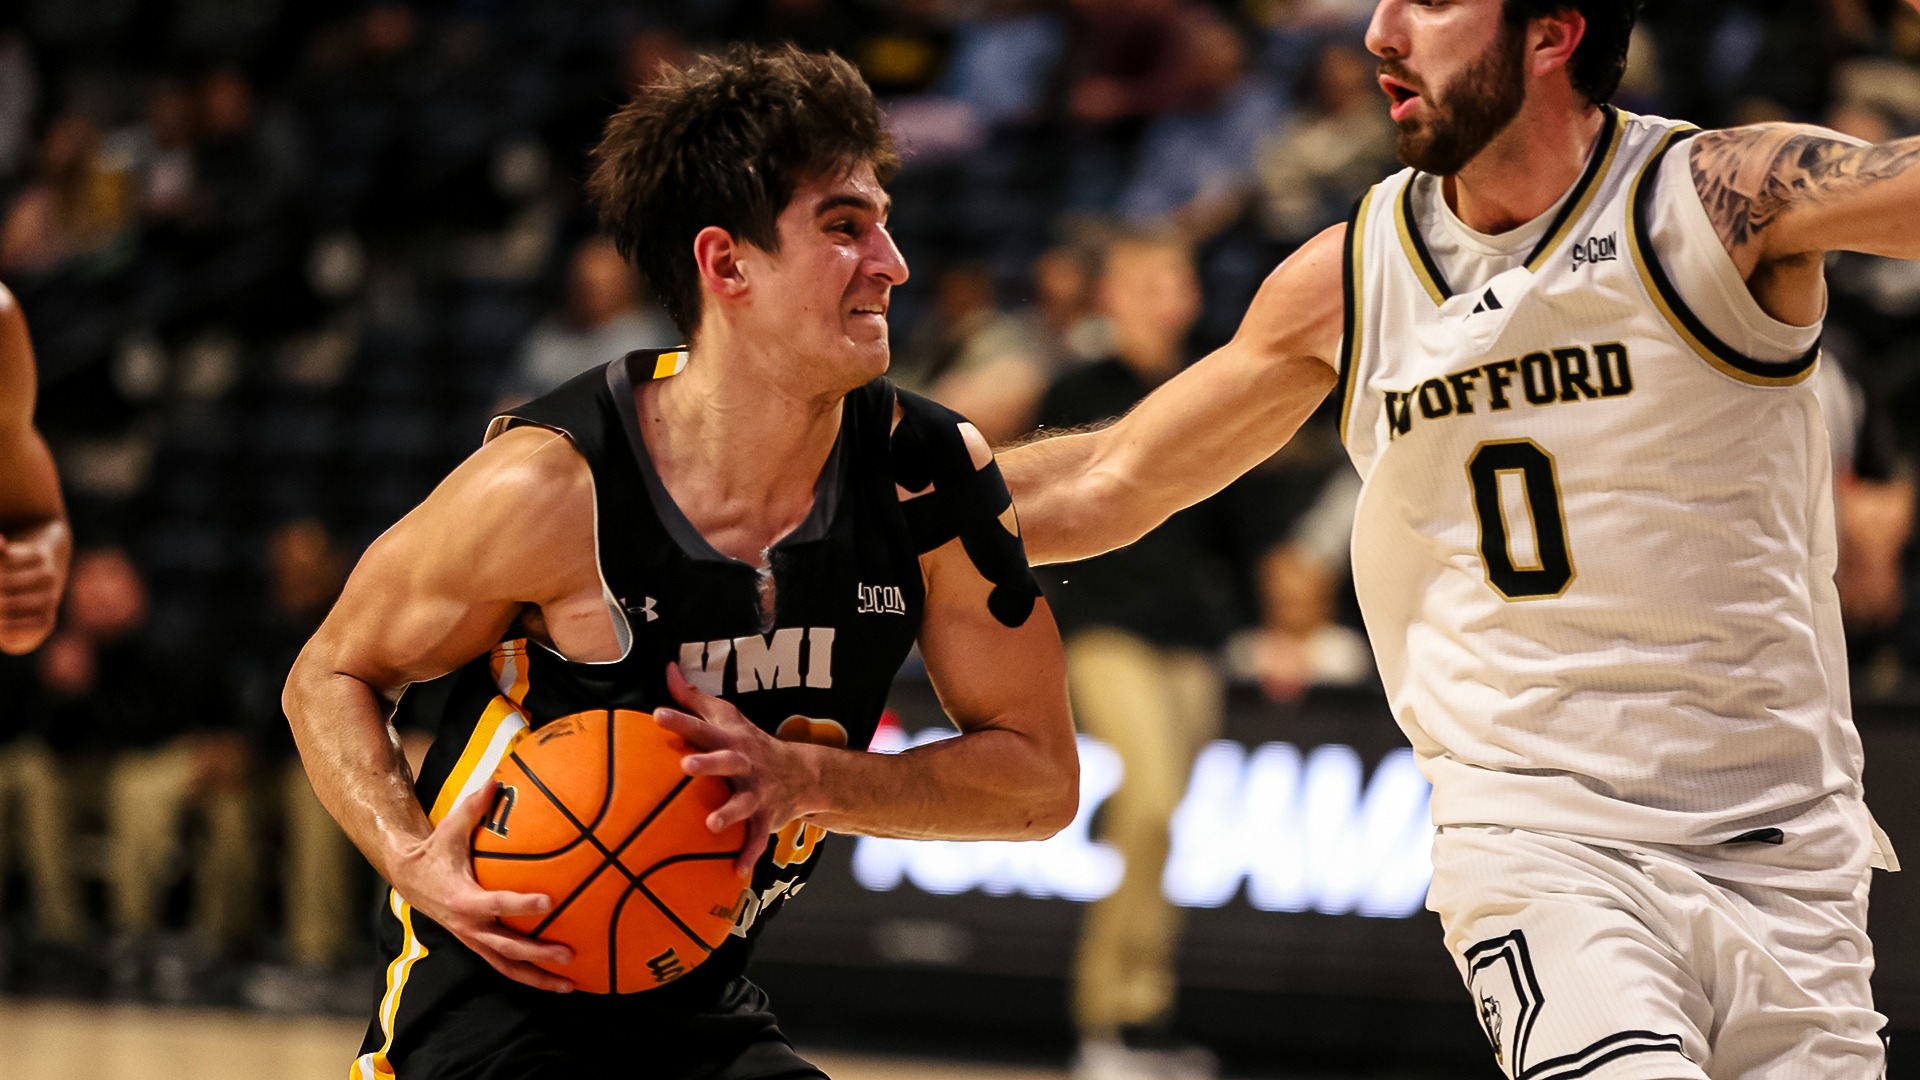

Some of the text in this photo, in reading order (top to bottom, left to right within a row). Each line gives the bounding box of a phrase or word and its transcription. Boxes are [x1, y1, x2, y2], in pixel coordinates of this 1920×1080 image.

[1383, 340, 1635, 441] WOFFORD
[1464, 436, 1577, 602] 0
[679, 627, 835, 696] VMI
